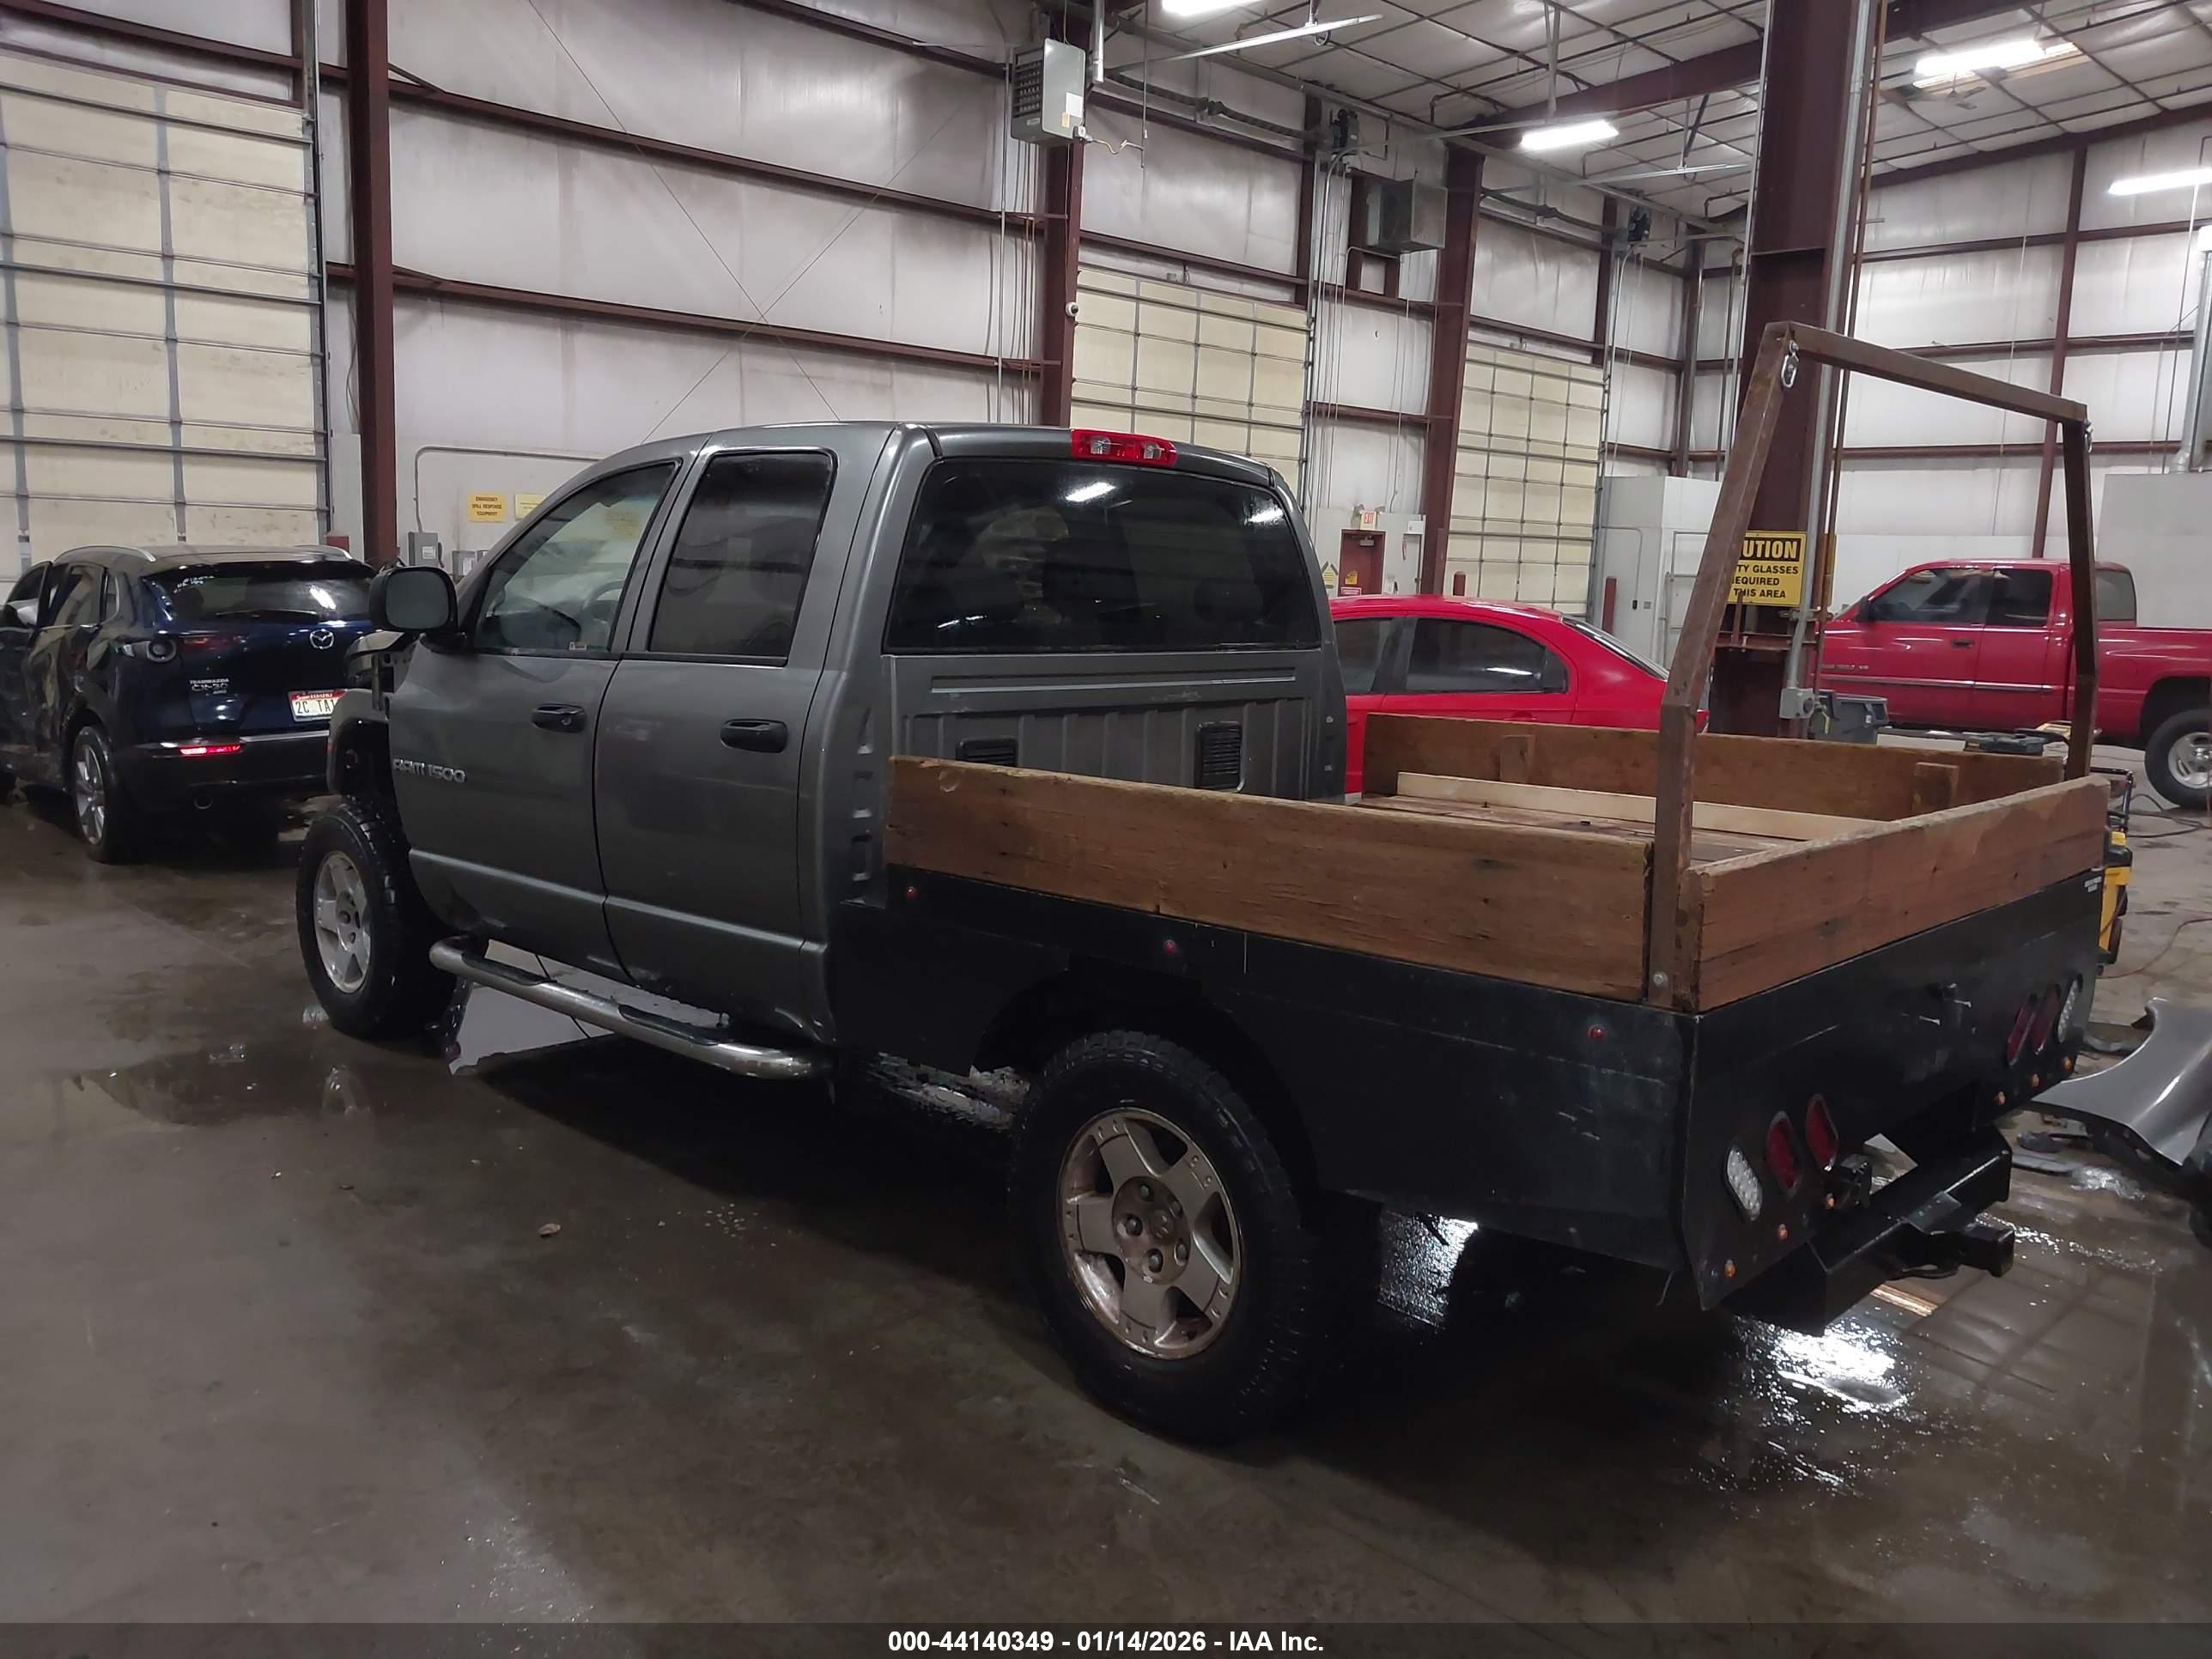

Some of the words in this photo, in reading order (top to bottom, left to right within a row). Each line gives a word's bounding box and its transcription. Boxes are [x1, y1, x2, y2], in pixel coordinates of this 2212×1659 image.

[1753, 565, 1799, 574] GLASSES
[1732, 576, 1779, 586] EQUIRED
[1759, 589, 1785, 599] AREA
[295, 701, 310, 714] 2C
[428, 763, 466, 783] 1500
